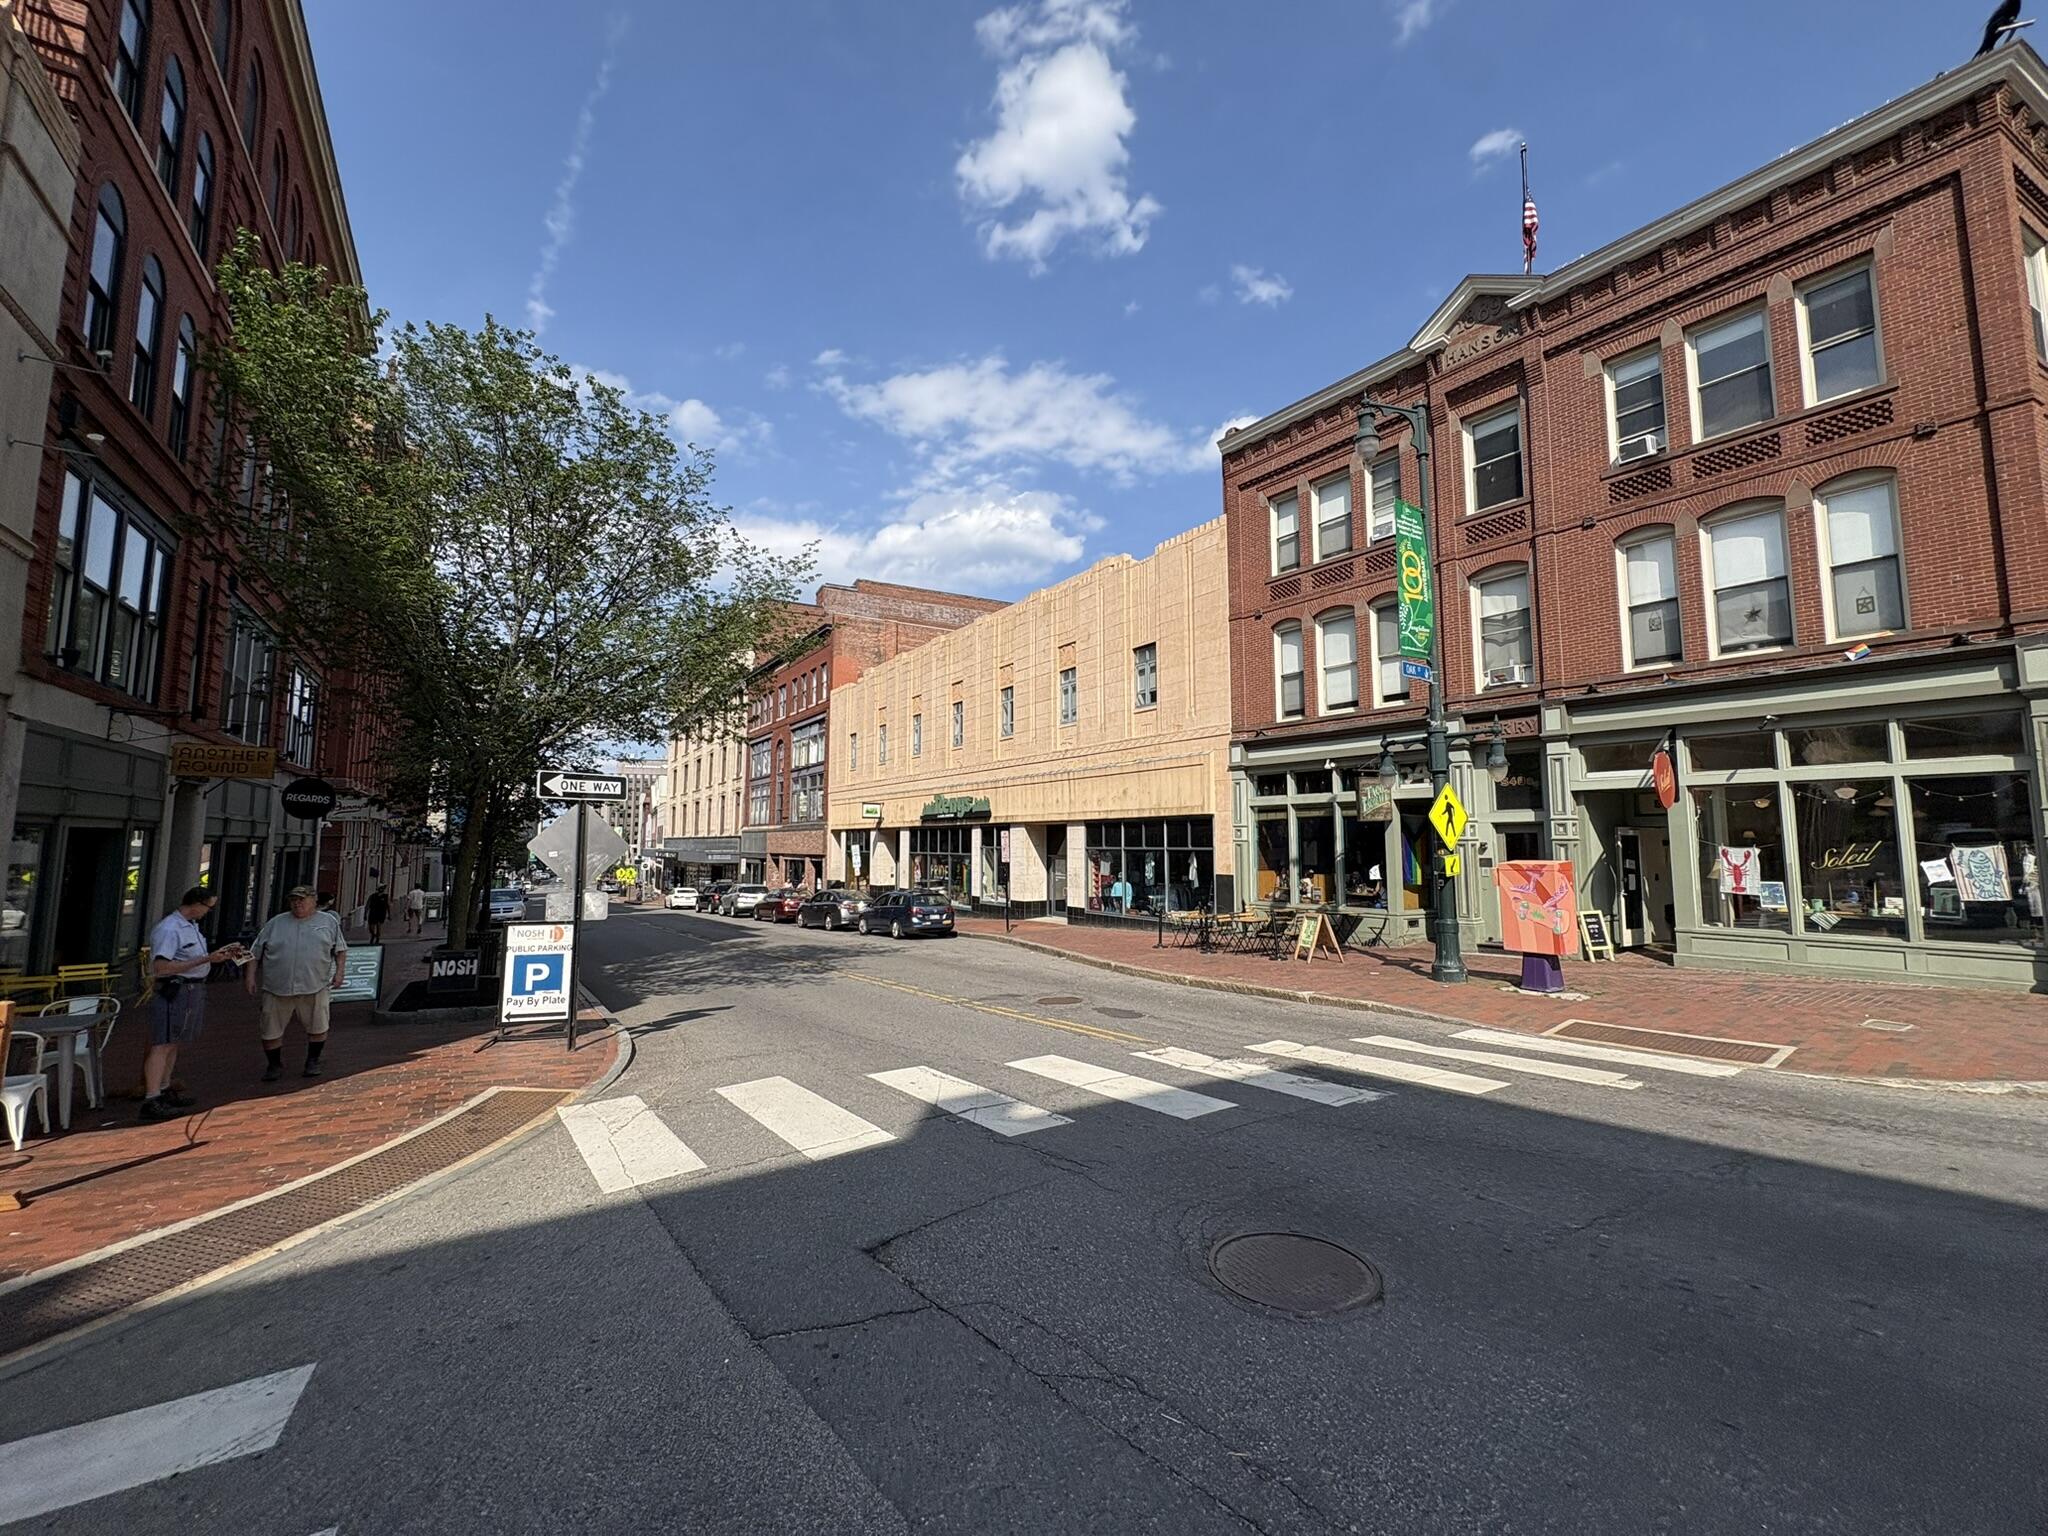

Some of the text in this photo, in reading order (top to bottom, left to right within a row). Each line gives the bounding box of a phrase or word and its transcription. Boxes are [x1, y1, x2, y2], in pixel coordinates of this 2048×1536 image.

[1445, 323, 1519, 367] HANSON
[178, 760, 249, 774] ROUND
[560, 781, 619, 793] ONE WAY
[286, 793, 331, 805] REGARDS
[1811, 840, 1882, 869] Soleil
[517, 929, 545, 938] NOSH
[432, 959, 478, 977] NOSH
[525, 963, 550, 991] P
[506, 996, 566, 1007] Pay By Plate
